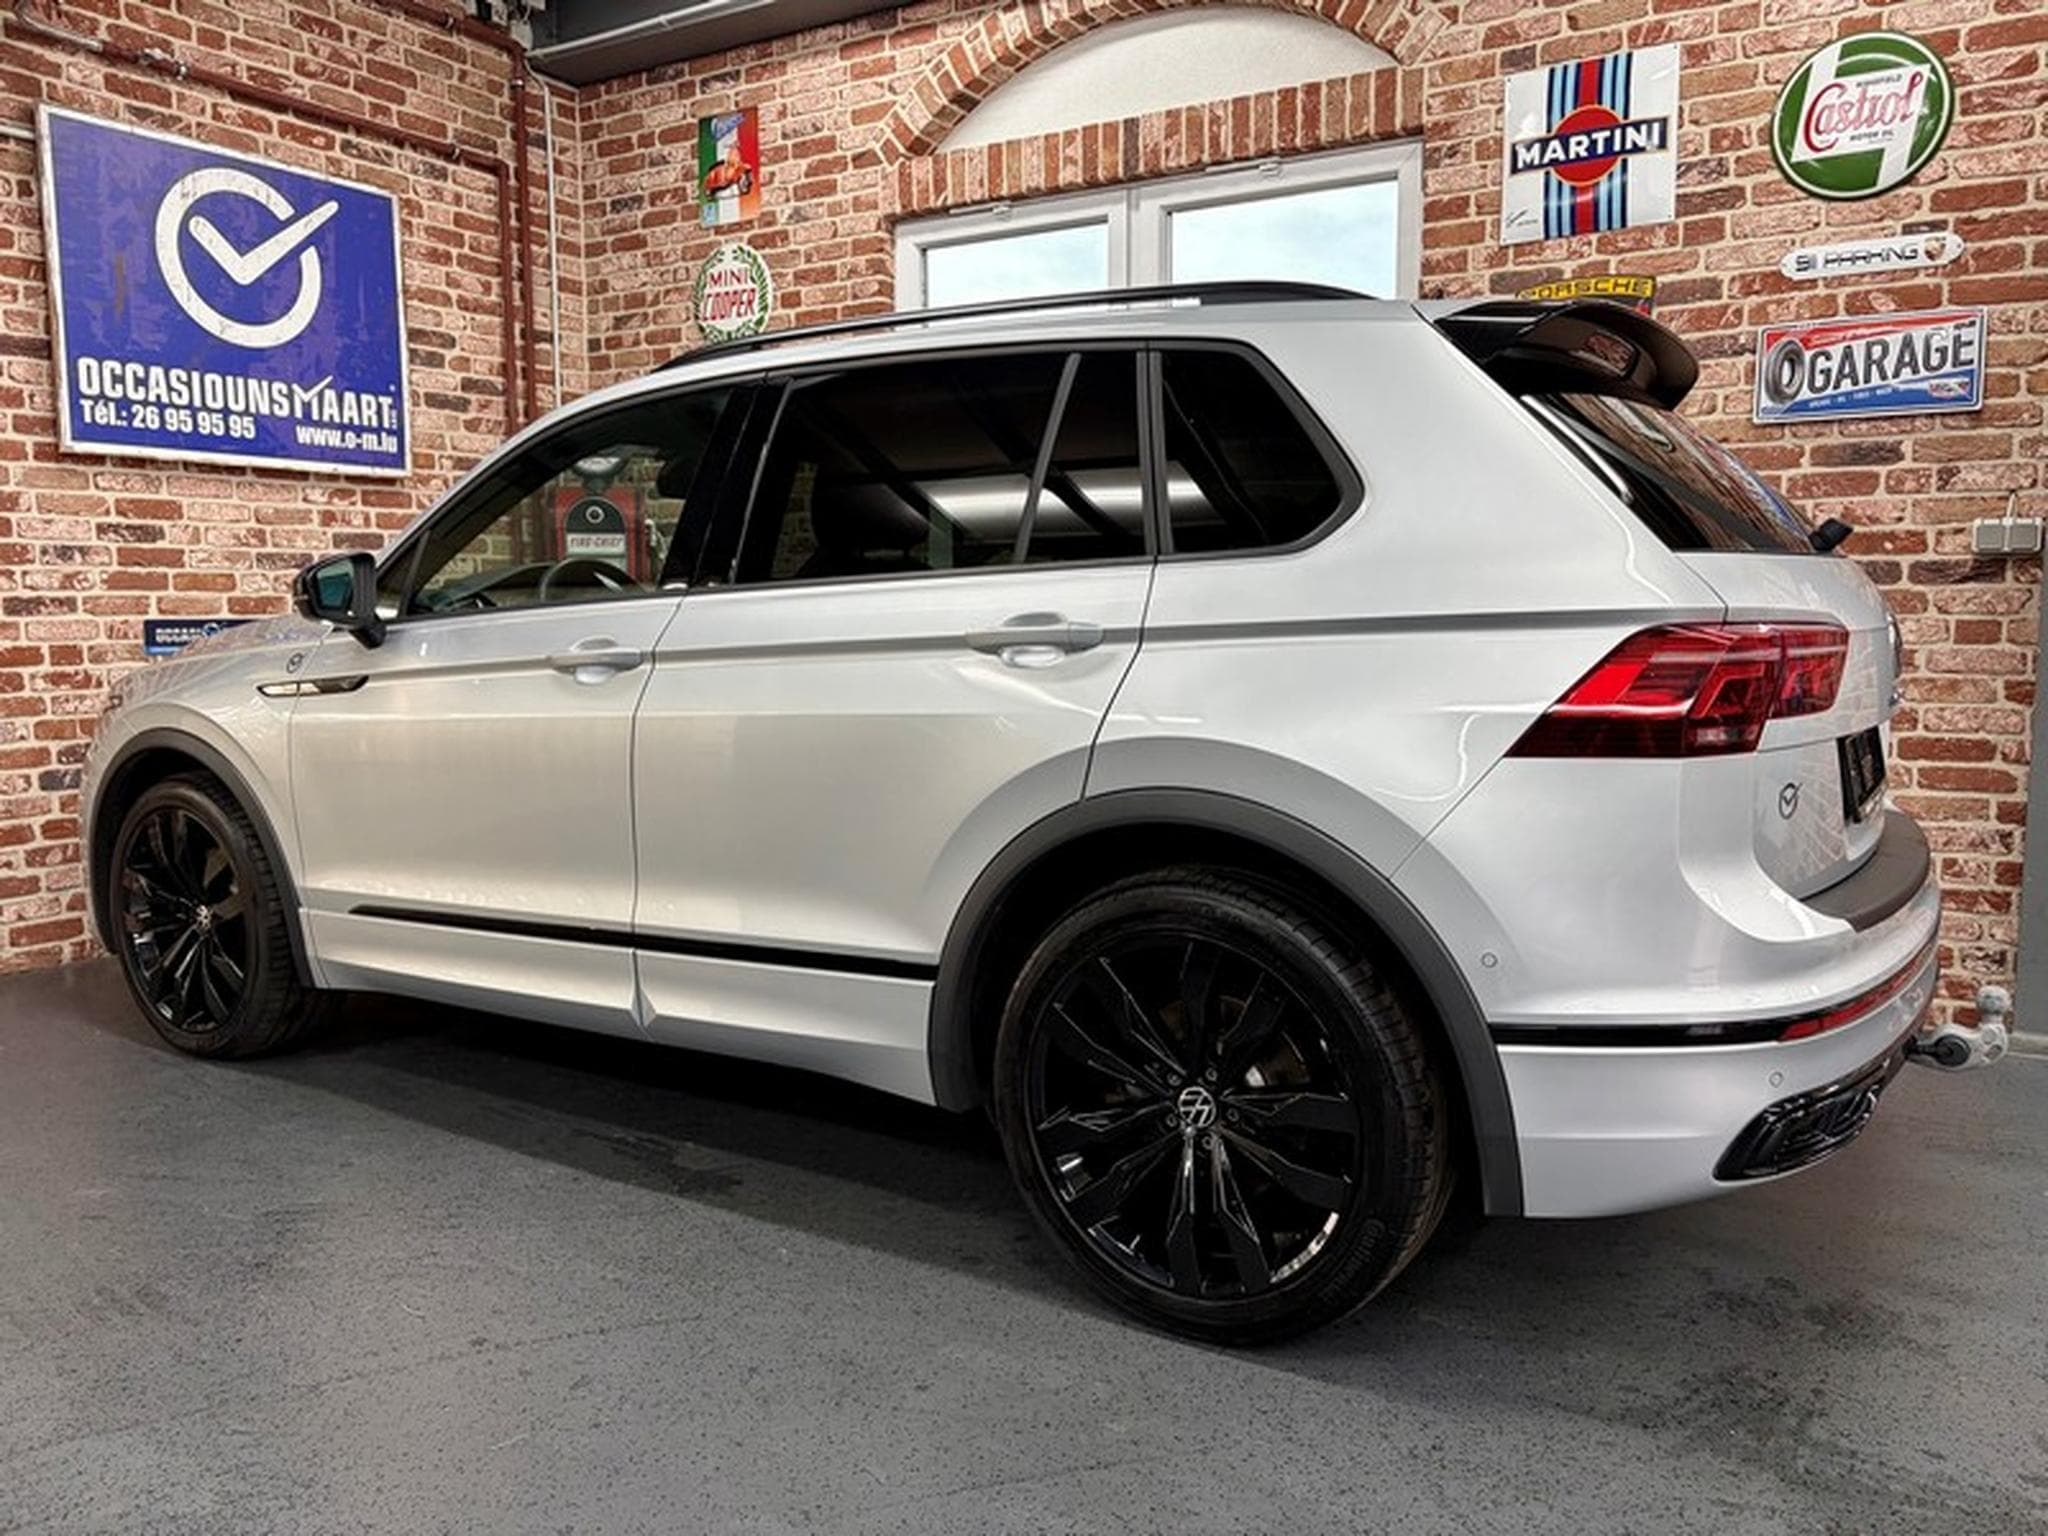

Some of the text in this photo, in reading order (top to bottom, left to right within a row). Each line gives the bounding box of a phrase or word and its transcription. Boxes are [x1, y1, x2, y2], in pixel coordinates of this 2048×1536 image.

[1803, 71, 1924, 153] Castrol
[1515, 121, 1661, 169] MARTINI
[1823, 243, 1919, 267] PARKING
[708, 268, 750, 289] MINI
[701, 288, 758, 323] COOPER
[1806, 319, 1977, 395] GARAGE
[77, 356, 393, 430] OCCASIOUNSMAART
[79, 398, 257, 440] Tél.: 26 95 95 95
[295, 425, 399, 454] www.o-m.lu
